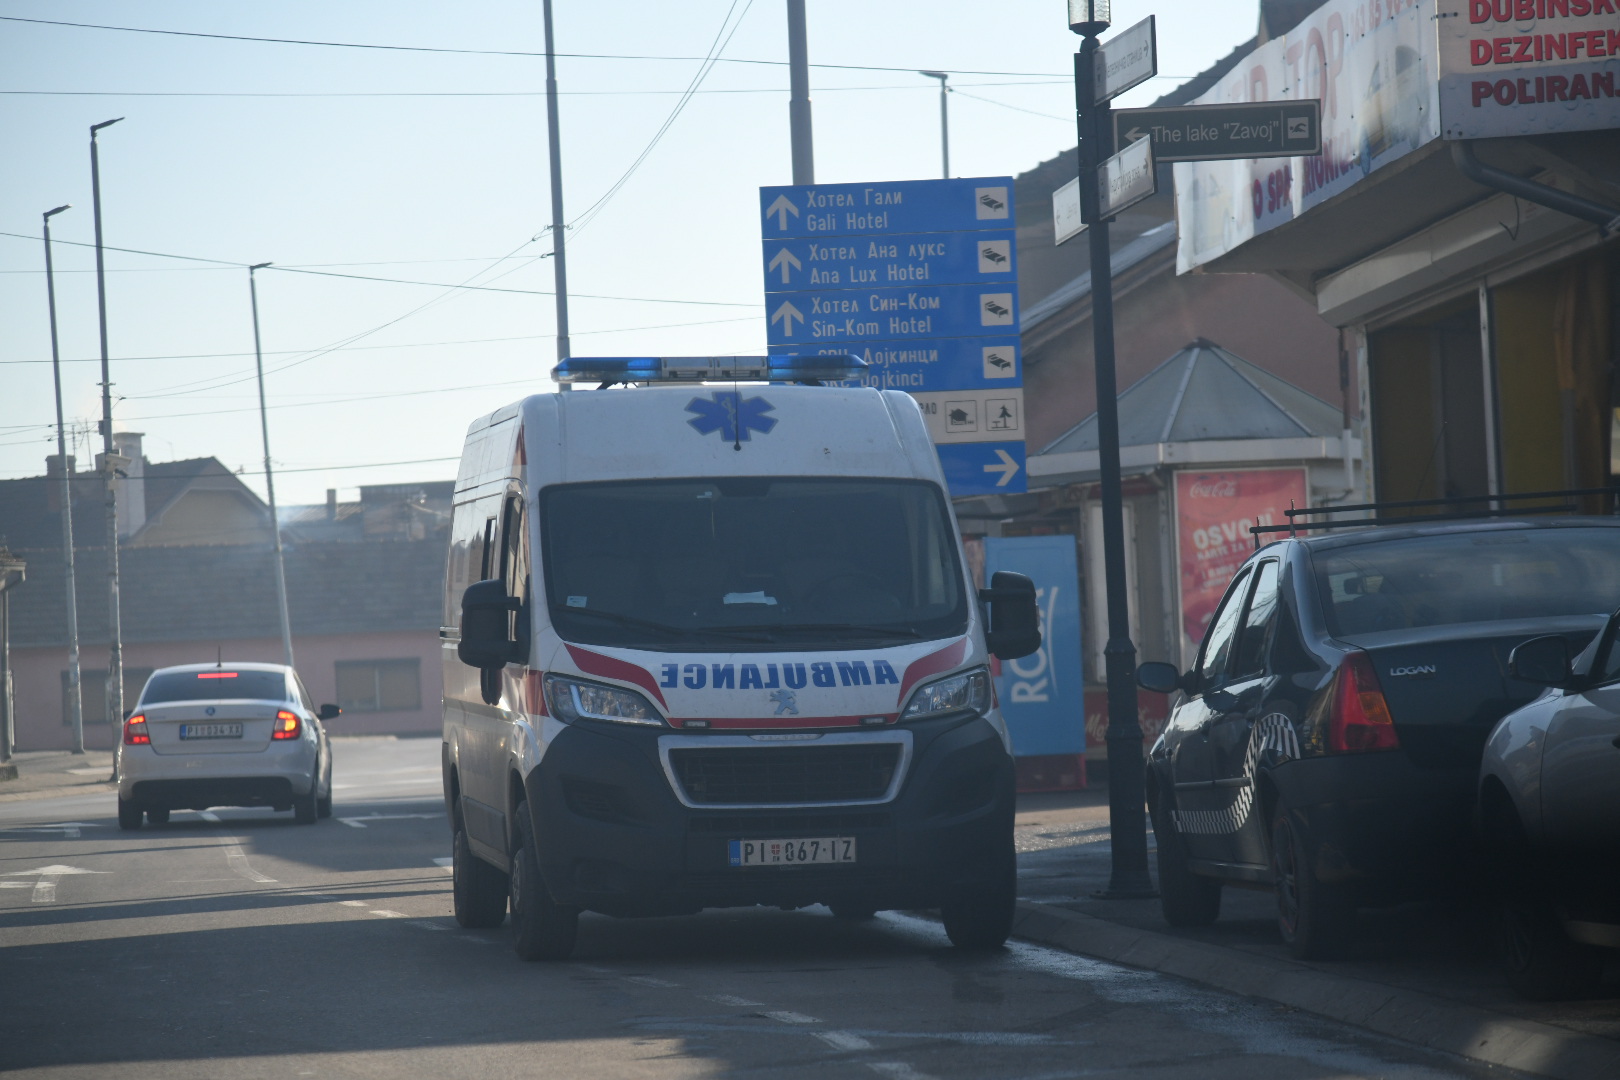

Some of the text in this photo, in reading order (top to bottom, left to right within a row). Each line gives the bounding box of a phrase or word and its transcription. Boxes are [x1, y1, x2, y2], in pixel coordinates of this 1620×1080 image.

[1469, 0, 1620, 24] DUBINSK
[1470, 29, 1620, 66] DEZINFEK
[1471, 71, 1620, 108] POLIRAN
[1151, 120, 1280, 145] The lake "Zavoj"
[807, 188, 903, 208] Хотел Гали
[807, 211, 888, 231] Gali Hotel
[809, 241, 946, 261] Хотел Ана лукс
[810, 262, 929, 285] Ana Lux Hotel
[811, 292, 940, 314] Хотел Син-Ком
[812, 315, 932, 338] Sin-Kom Hotel
[863, 347, 939, 369] Дојкинци
[1390, 664, 1437, 676] LOGAN
